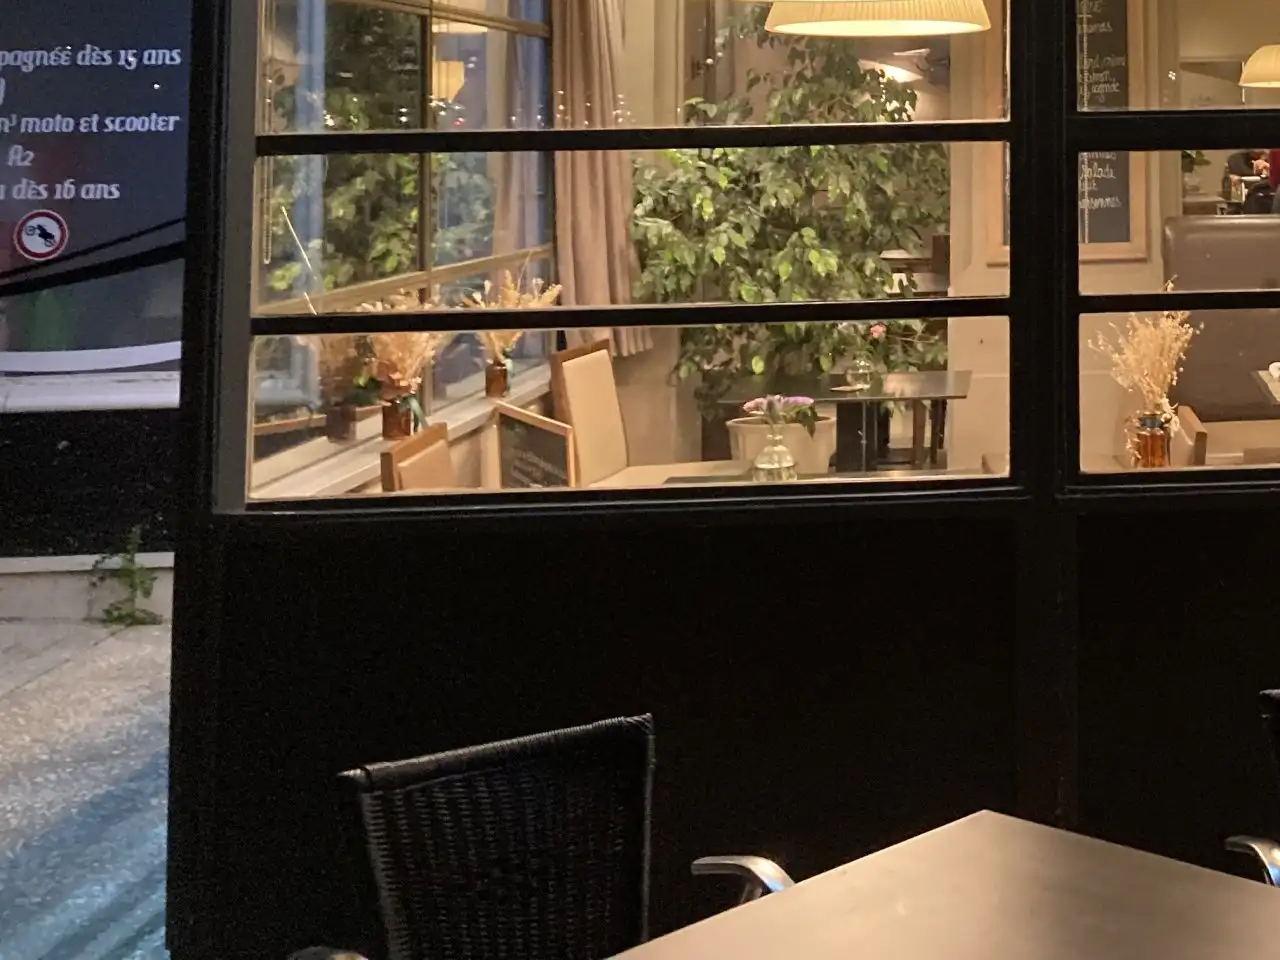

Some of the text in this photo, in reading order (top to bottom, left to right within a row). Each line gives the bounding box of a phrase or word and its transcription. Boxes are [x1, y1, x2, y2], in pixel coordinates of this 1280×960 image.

[143, 49, 182, 66] ans
[20, 114, 75, 133] moto
[79, 114, 100, 133] et
[103, 112, 181, 133] scooter
[81, 183, 120, 200] ans
